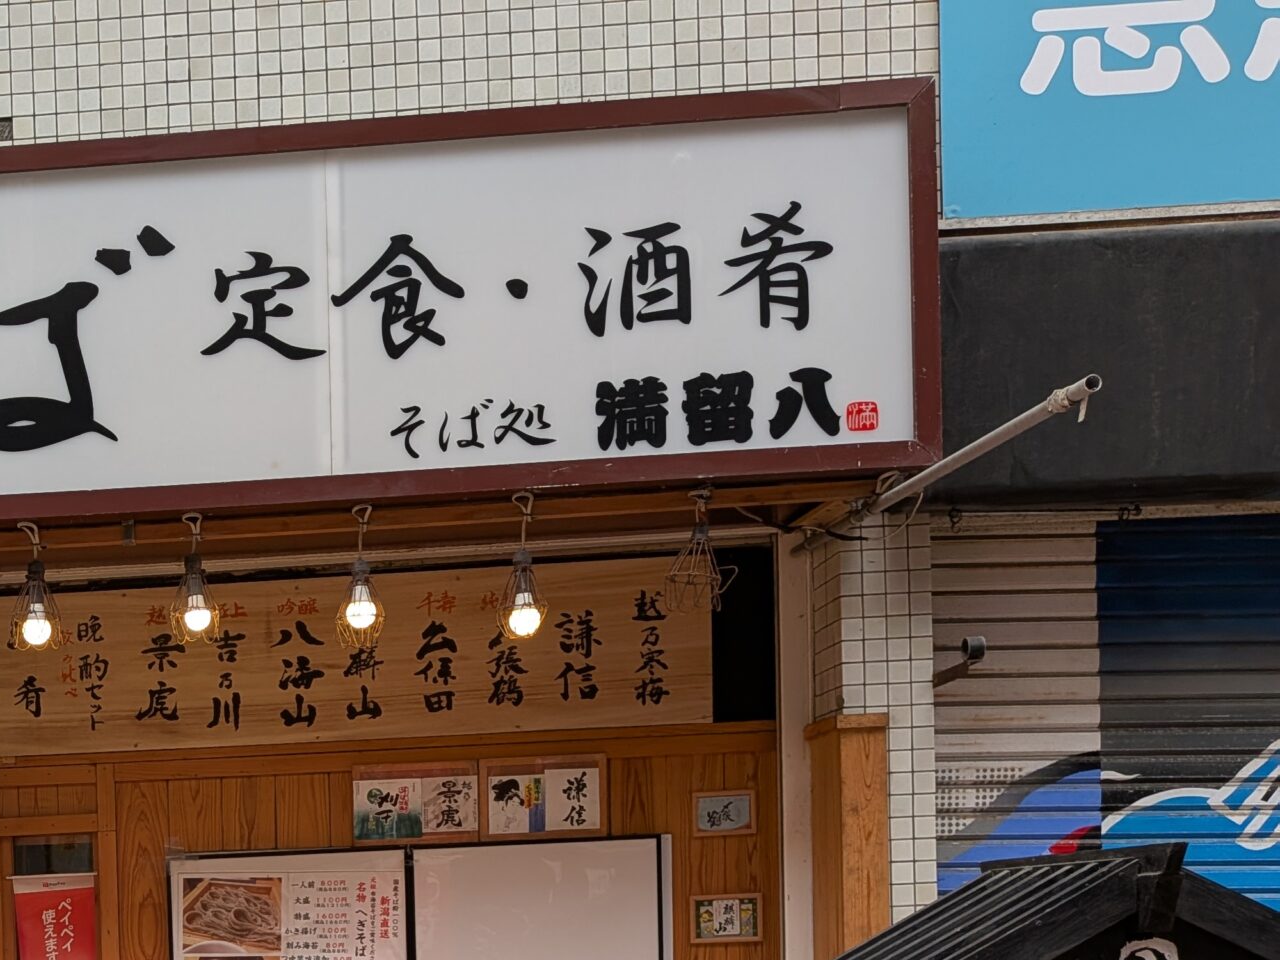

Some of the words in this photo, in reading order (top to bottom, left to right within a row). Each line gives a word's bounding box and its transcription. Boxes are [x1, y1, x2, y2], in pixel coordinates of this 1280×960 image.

[389, 397, 557, 460] そば処
[595, 366, 842, 452] 満留八
[135, 633, 185, 721] 景虎
[207, 630, 246, 731] 吉乃川
[271, 620, 324, 727] 八海山
[414, 620, 458, 713] 久保田
[554, 609, 602, 701] 謙信
[632, 589, 670, 706] 越乃寒梅
[436, 780, 463, 828] 景虎
[563, 772, 587, 826] 謙信
[58, 898, 74, 952] ペイペイ
[355, 910, 367, 957] へぎそば
[380, 896, 390, 939] 新潟直送
